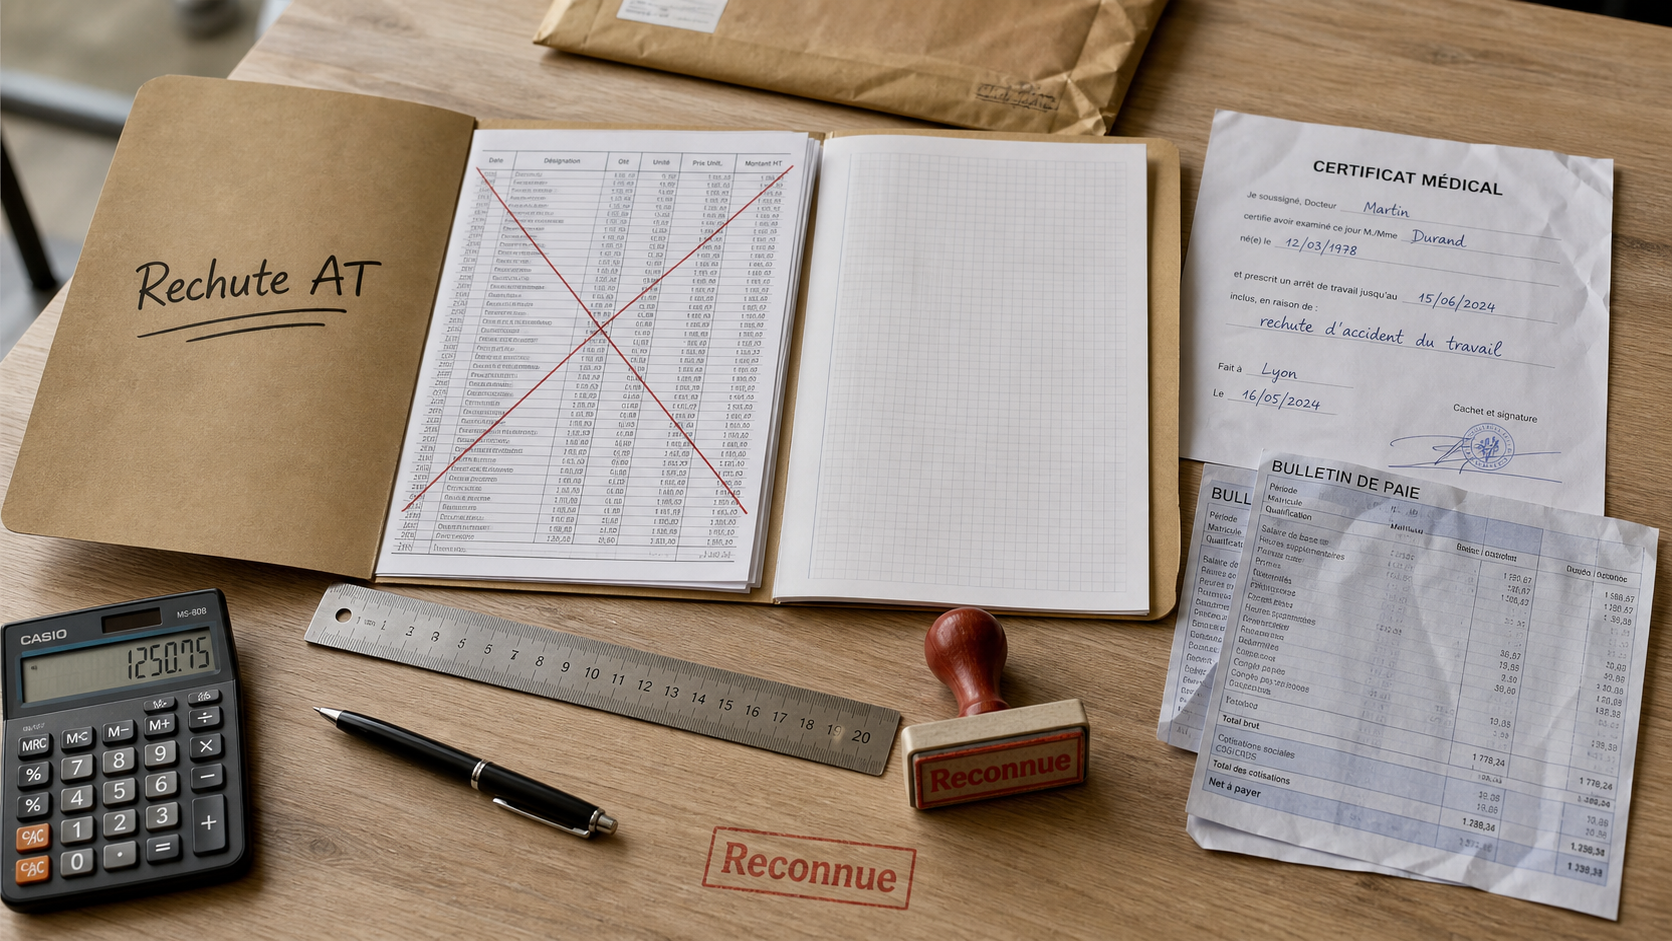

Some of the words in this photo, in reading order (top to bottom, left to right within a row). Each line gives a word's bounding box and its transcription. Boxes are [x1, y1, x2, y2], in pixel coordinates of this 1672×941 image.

[1312, 159, 1416, 185] CERTIFICAT
[1421, 171, 1504, 197] MÉDICAL
[1246, 190, 1257, 200] Je
[1258, 192, 1302, 207] soussigné,
[1304, 198, 1337, 211] Docteur
[1363, 201, 1410, 219] Martin
[1243, 212, 1272, 223] certifie
[1274, 216, 1294, 226] avoir
[1295, 218, 1331, 231] examiné
[1332, 224, 1343, 232] ce
[1343, 224, 1362, 237] jour
[1362, 227, 1398, 240] M./Mme
[1240, 234, 1262, 247] né(e)
[1263, 237, 1272, 246] le
[1284, 236, 1358, 257] 12/03/1978
[1411, 228, 1467, 249] Durand
[135, 257, 290, 311] Rechute
[309, 254, 383, 298] AT
[1234, 270, 1243, 280] et
[1244, 272, 1278, 286] prescrit
[1279, 277, 1292, 286] un
[1293, 276, 1315, 289] arrêt
[1316, 280, 1329, 291] de
[1330, 283, 1358, 296] travail
[1358, 286, 1398, 303] jusqu'au
[1230, 292, 1258, 304] inclus,
[1260, 296, 1272, 305] en
[1273, 298, 1300, 309] raison
[1302, 302, 1314, 312] de
[1417, 292, 1496, 314] 15/06/2024
[1259, 315, 1314, 334] rechute
[1325, 322, 1404, 345] d'accident
[1415, 331, 1436, 349] du
[1446, 336, 1503, 358] travail
[1218, 362, 1234, 373] Fait
[1236, 364, 1243, 374] à
[1261, 362, 1298, 384] Lyon
[1213, 389, 1224, 399] Le
[1241, 388, 1321, 411] 16/05/2024
[1453, 404, 1484, 417] Cachet
[1486, 409, 1494, 418] et
[1496, 410, 1538, 425] signature
[1269, 482, 1298, 494] Période
[1272, 460, 1352, 484] BULLETIN
[1356, 474, 1380, 492] DE
[1383, 480, 1421, 501] PAIE
[1212, 486, 1252, 506] BULL
[1268, 494, 1302, 507] Matricule
[1210, 510, 1238, 522] Période
[1266, 505, 1312, 521] Qualification
[1208, 523, 1242, 536] Matricule
[20, 629, 68, 646] CASIO
[127, 636, 210, 680] 1250.75
[483, 644, 494, 655] 5
[509, 650, 520, 661] 7
[535, 655, 545, 668] 8
[560, 661, 571, 674] 9
[584, 666, 600, 680] 10
[611, 673, 626, 687] 11
[636, 679, 654, 693] 12
[664, 685, 680, 699] 13
[691, 692, 706, 706] 14
[718, 698, 734, 712] 15
[745, 704, 761, 718] 16
[772, 711, 788, 724] 17
[800, 717, 816, 731] 18
[827, 724, 843, 738] 19
[851, 730, 872, 744] 20
[149, 718, 170, 731] M+
[1222, 714, 1242, 726] Total
[1243, 720, 1260, 730] brut
[22, 737, 48, 752] MRC
[1264, 746, 1296, 760] sociales
[113, 752, 125, 768] 8
[154, 746, 167, 762] 9
[26, 766, 42, 782] %
[71, 759, 83, 776] 7
[929, 752, 1072, 794] Reconnue
[1213, 760, 1232, 772] Total
[1232, 765, 1247, 776] des
[1248, 769, 1291, 786] cotisations
[114, 782, 126, 800] 5
[155, 776, 168, 792] 6
[1208, 777, 1225, 789] Net
[1234, 785, 1262, 798] payer
[25, 797, 40, 812] %
[70, 790, 84, 806] 4
[114, 814, 126, 832] 2
[156, 807, 168, 824] 3
[72, 821, 81, 838] 1
[70, 853, 84, 871] 0
[720, 841, 897, 894] Reconnue
